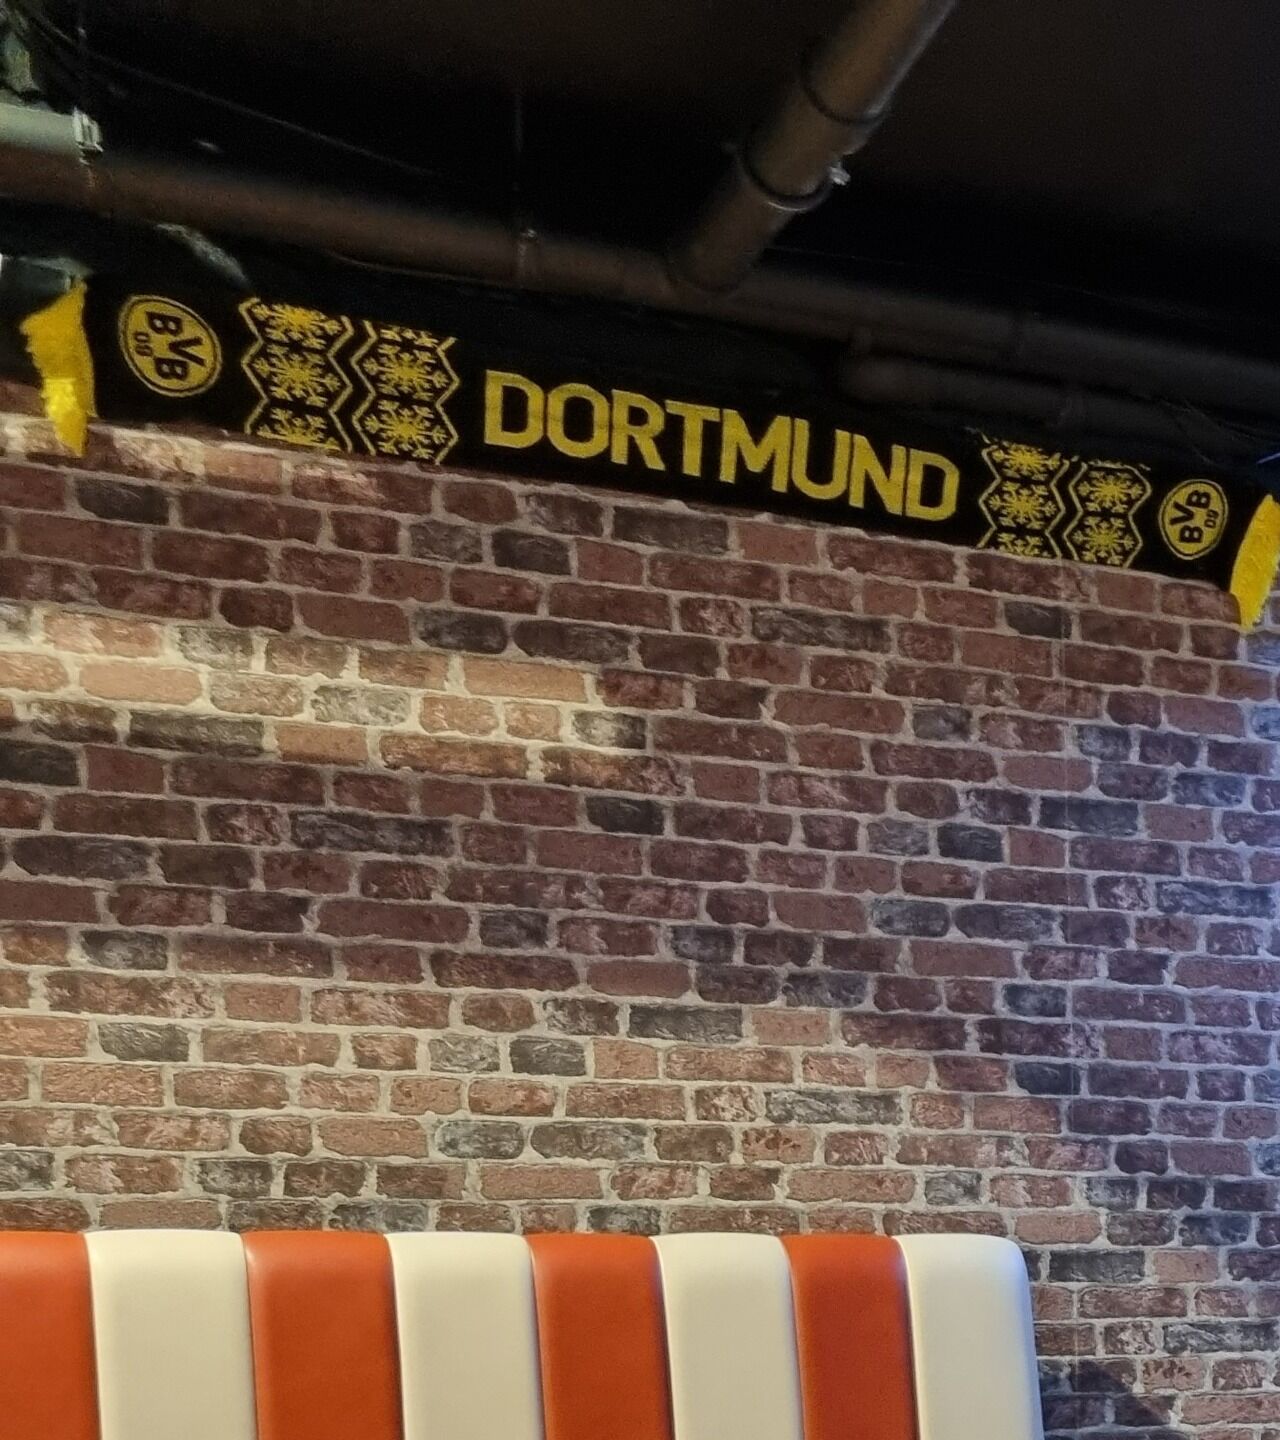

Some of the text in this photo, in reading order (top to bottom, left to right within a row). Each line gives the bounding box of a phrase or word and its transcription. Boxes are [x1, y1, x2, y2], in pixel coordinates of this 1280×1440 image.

[146, 310, 207, 381] BVB
[484, 369, 959, 521] DORTMUND
[1170, 489, 1212, 544] BVB
